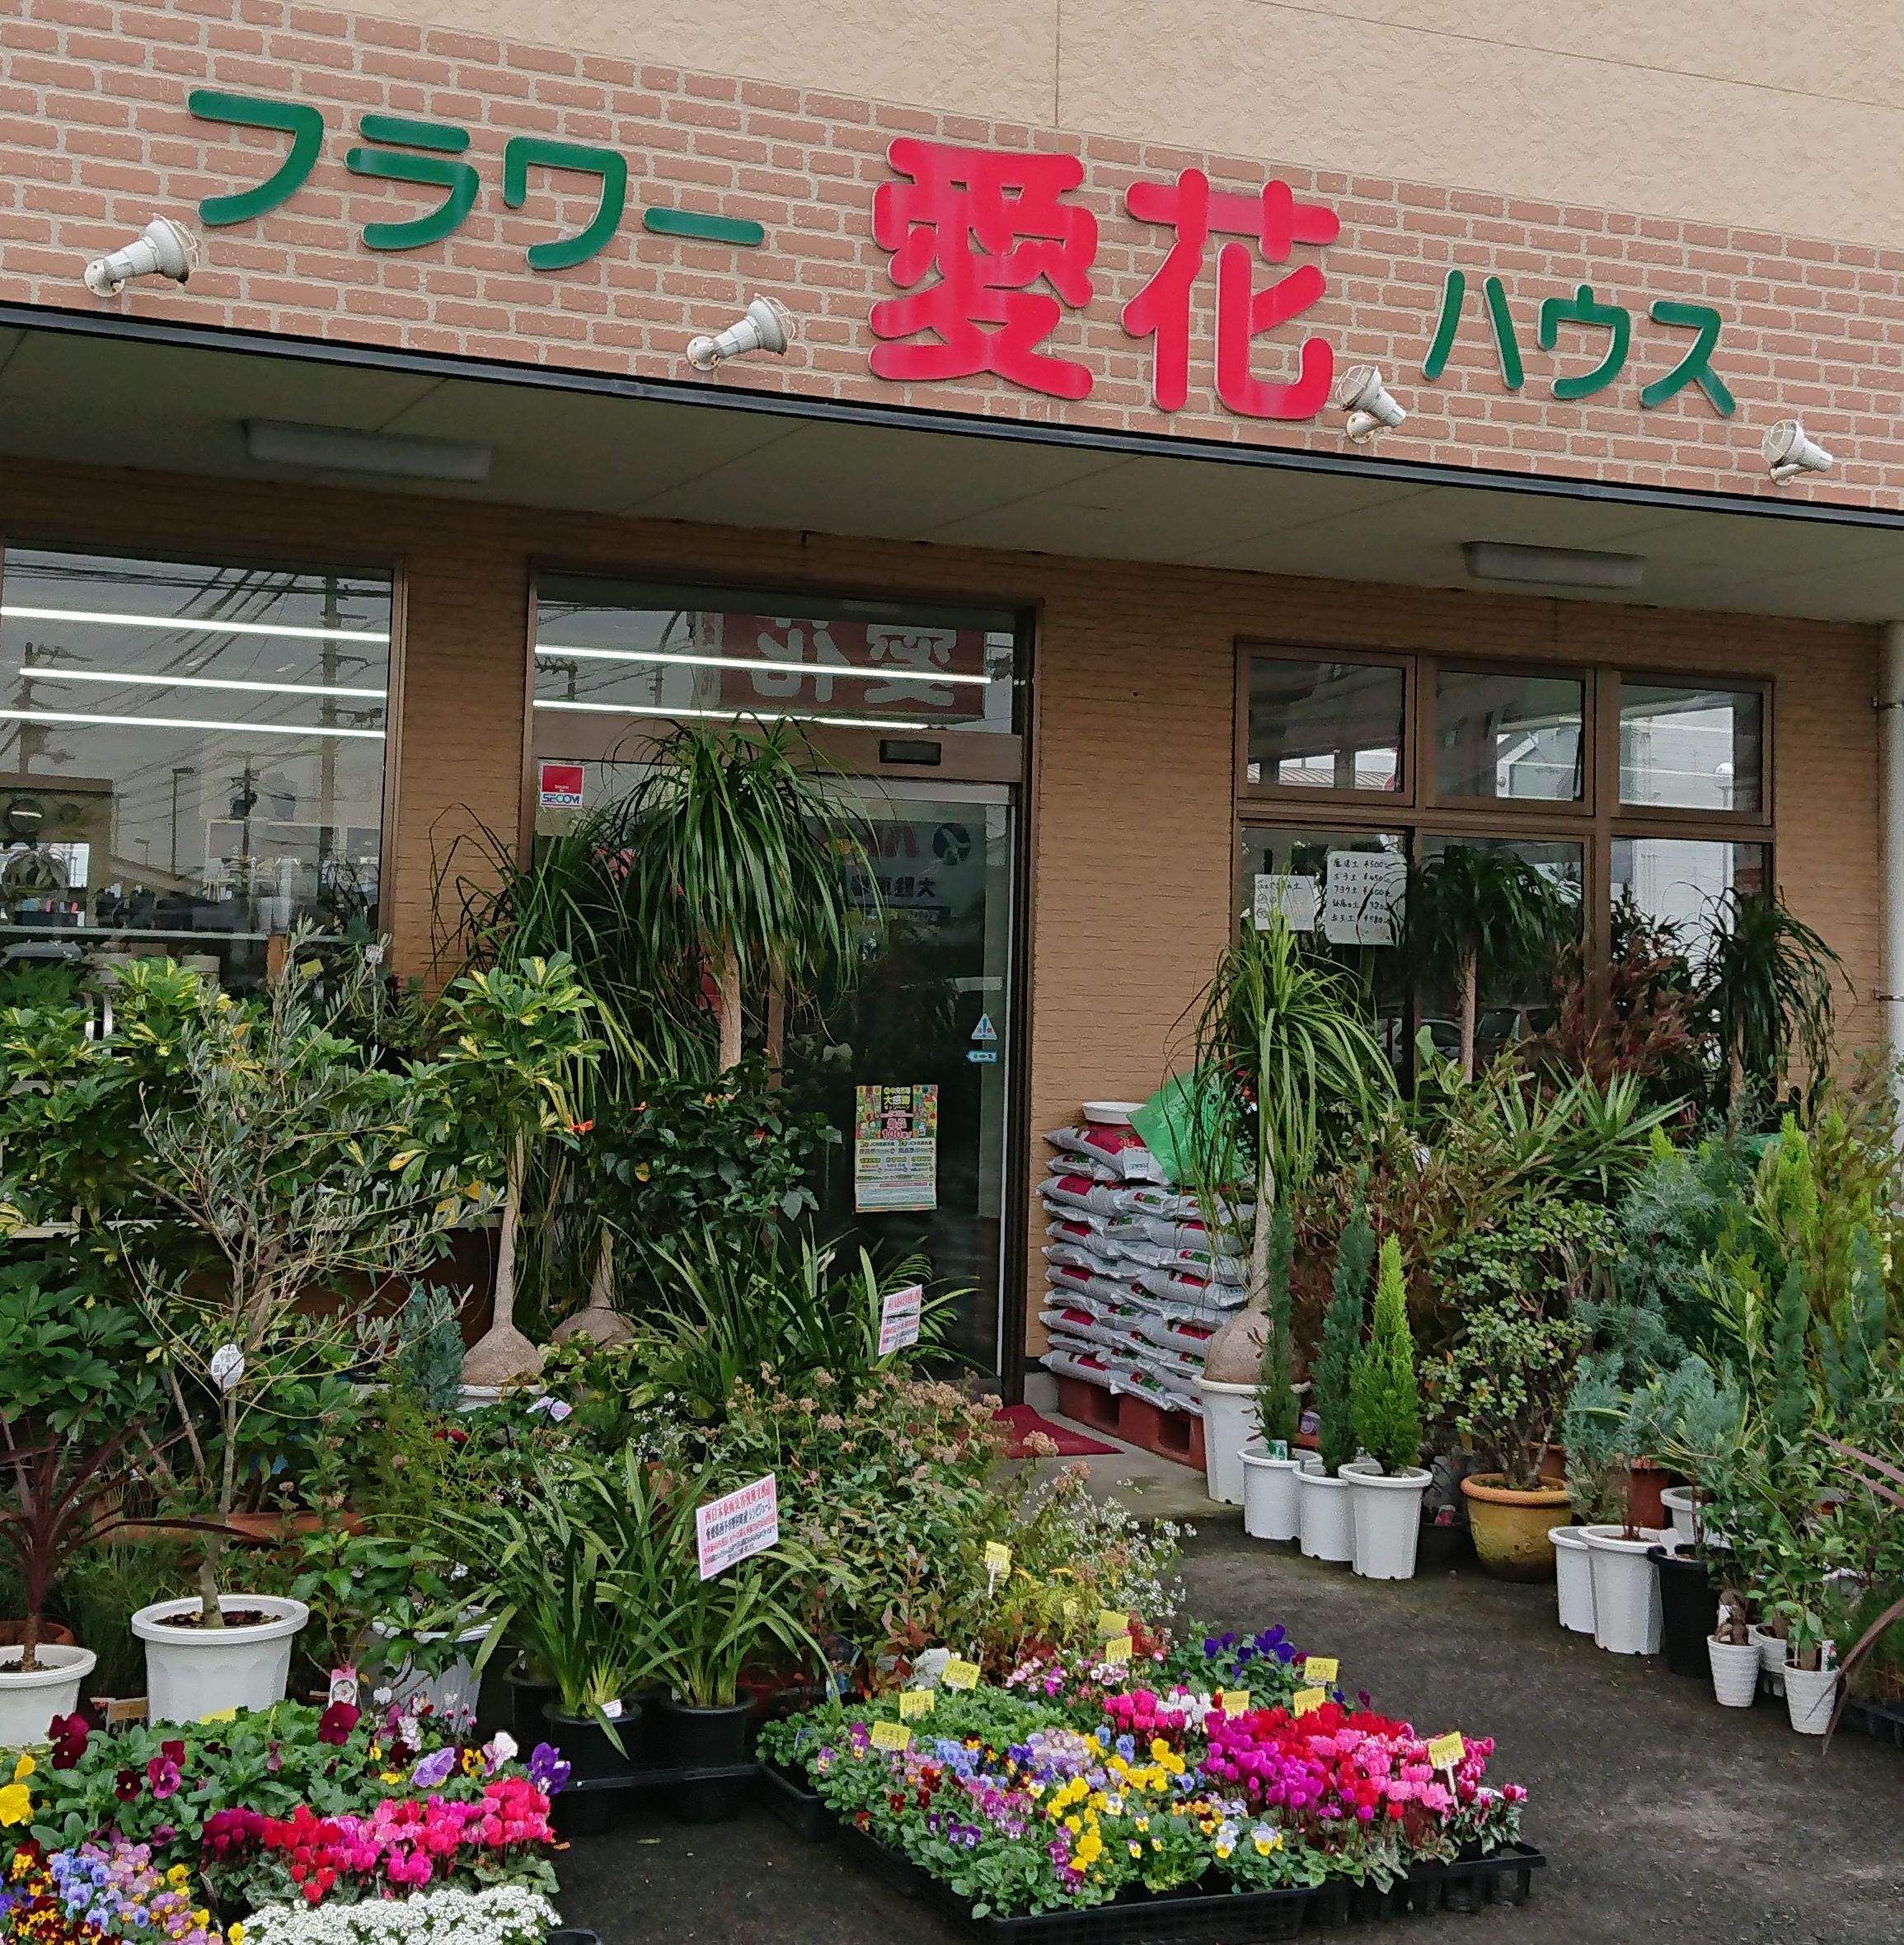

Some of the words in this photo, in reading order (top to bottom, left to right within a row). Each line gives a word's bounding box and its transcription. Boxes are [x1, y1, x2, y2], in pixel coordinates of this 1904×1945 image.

[189, 91, 763, 267] フラワー
[870, 138, 1341, 421] 愛花
[1425, 270, 1734, 415] ハウス
[542, 794, 580, 804] SECOM
